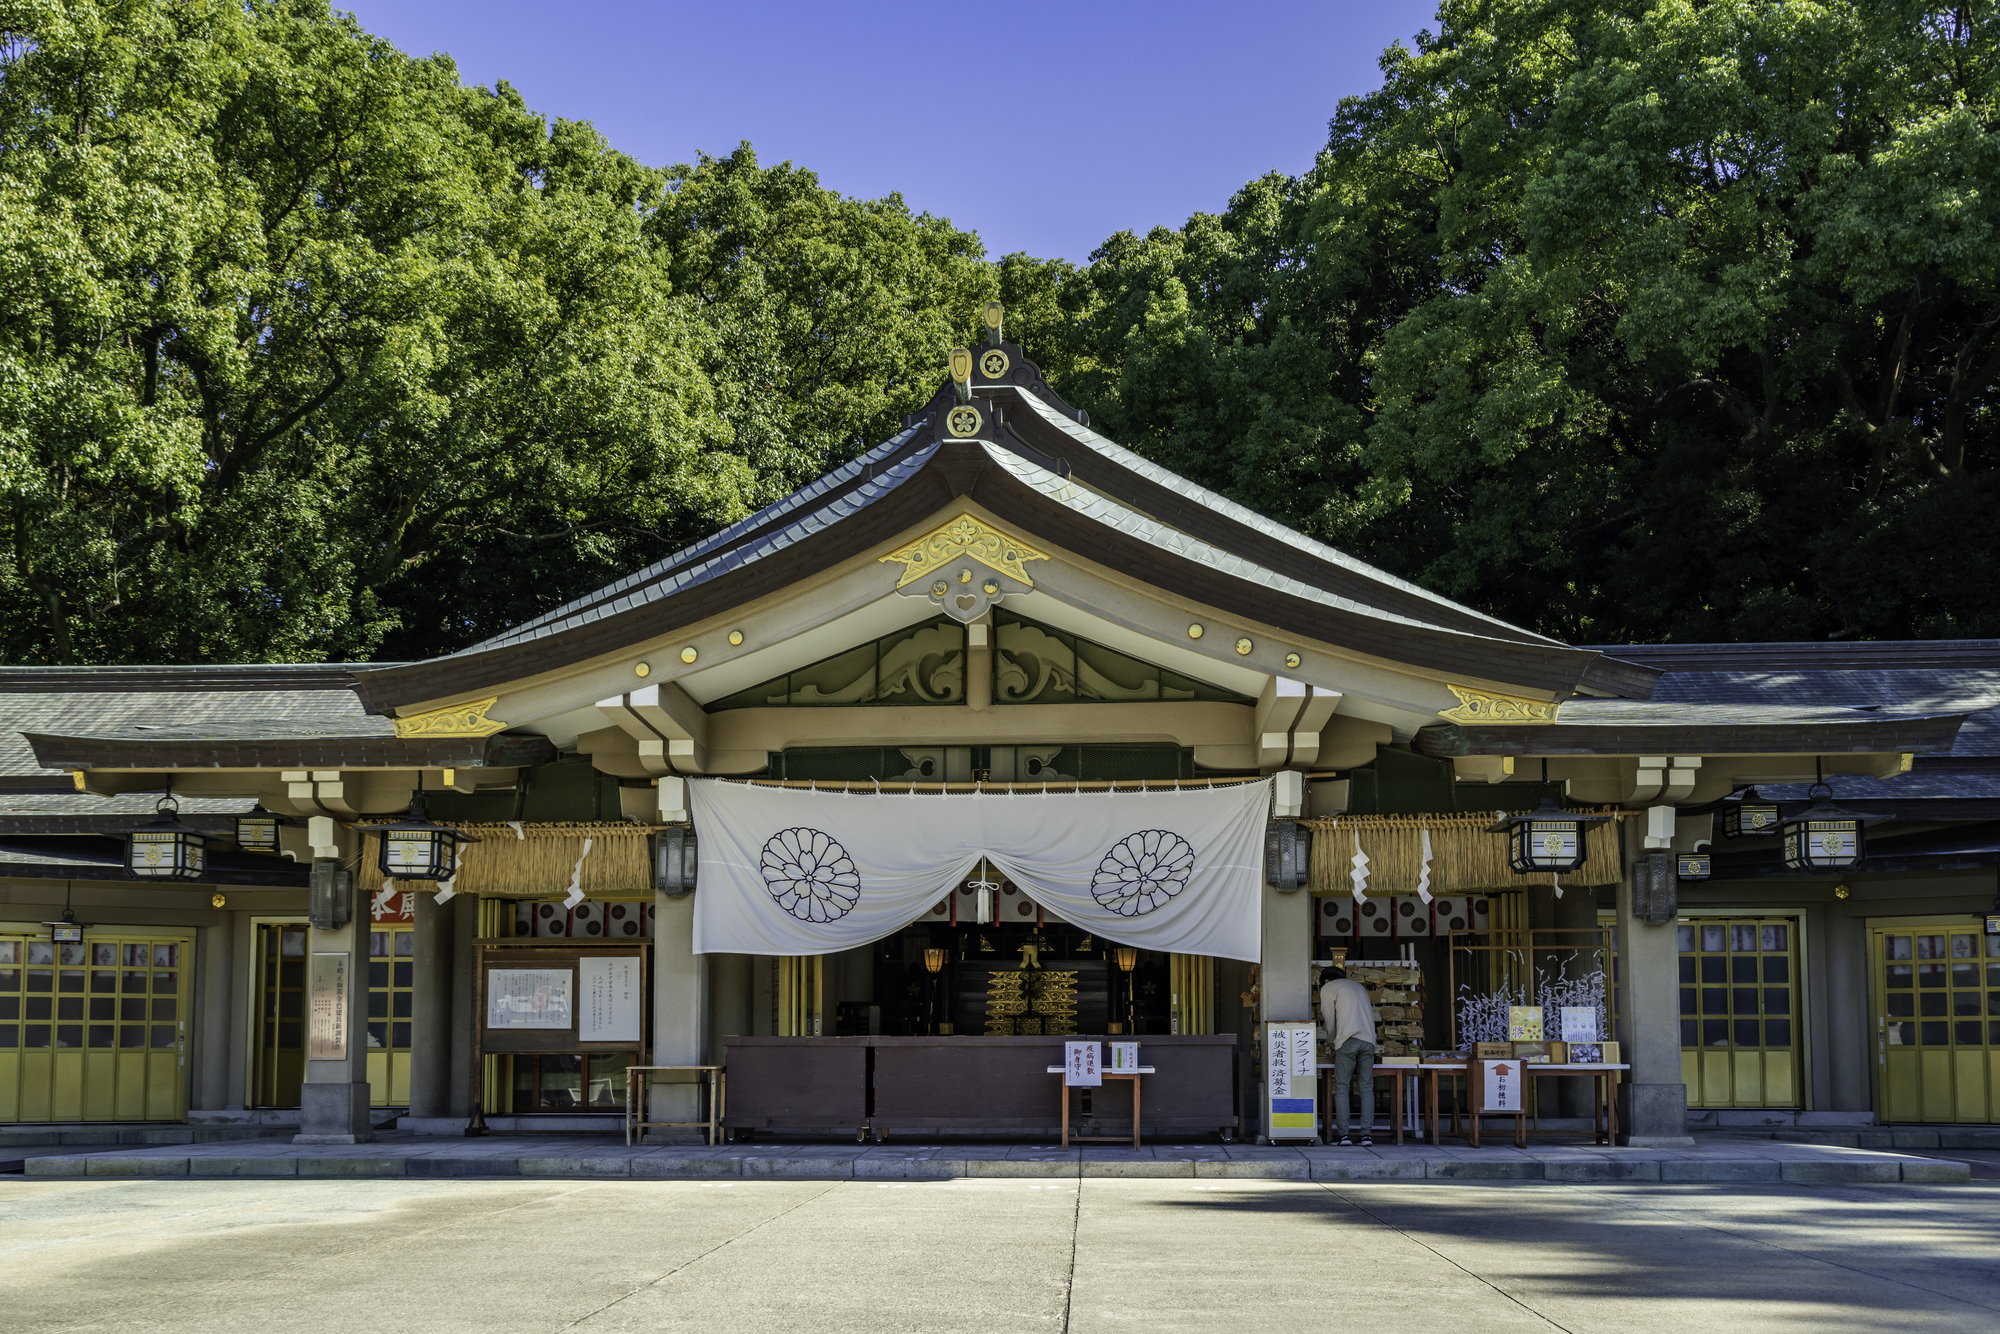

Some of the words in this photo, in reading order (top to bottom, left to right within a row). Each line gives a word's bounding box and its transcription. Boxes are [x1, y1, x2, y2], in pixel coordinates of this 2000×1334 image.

[1073, 1048, 1082, 1079] 御身守り
[1086, 1044, 1095, 1075] 疫病退散
[1272, 1030, 1287, 1095] 被災者救済募金
[1295, 1031, 1310, 1076] ウクライナ
[1498, 1076, 1506, 1108] お初穂料
